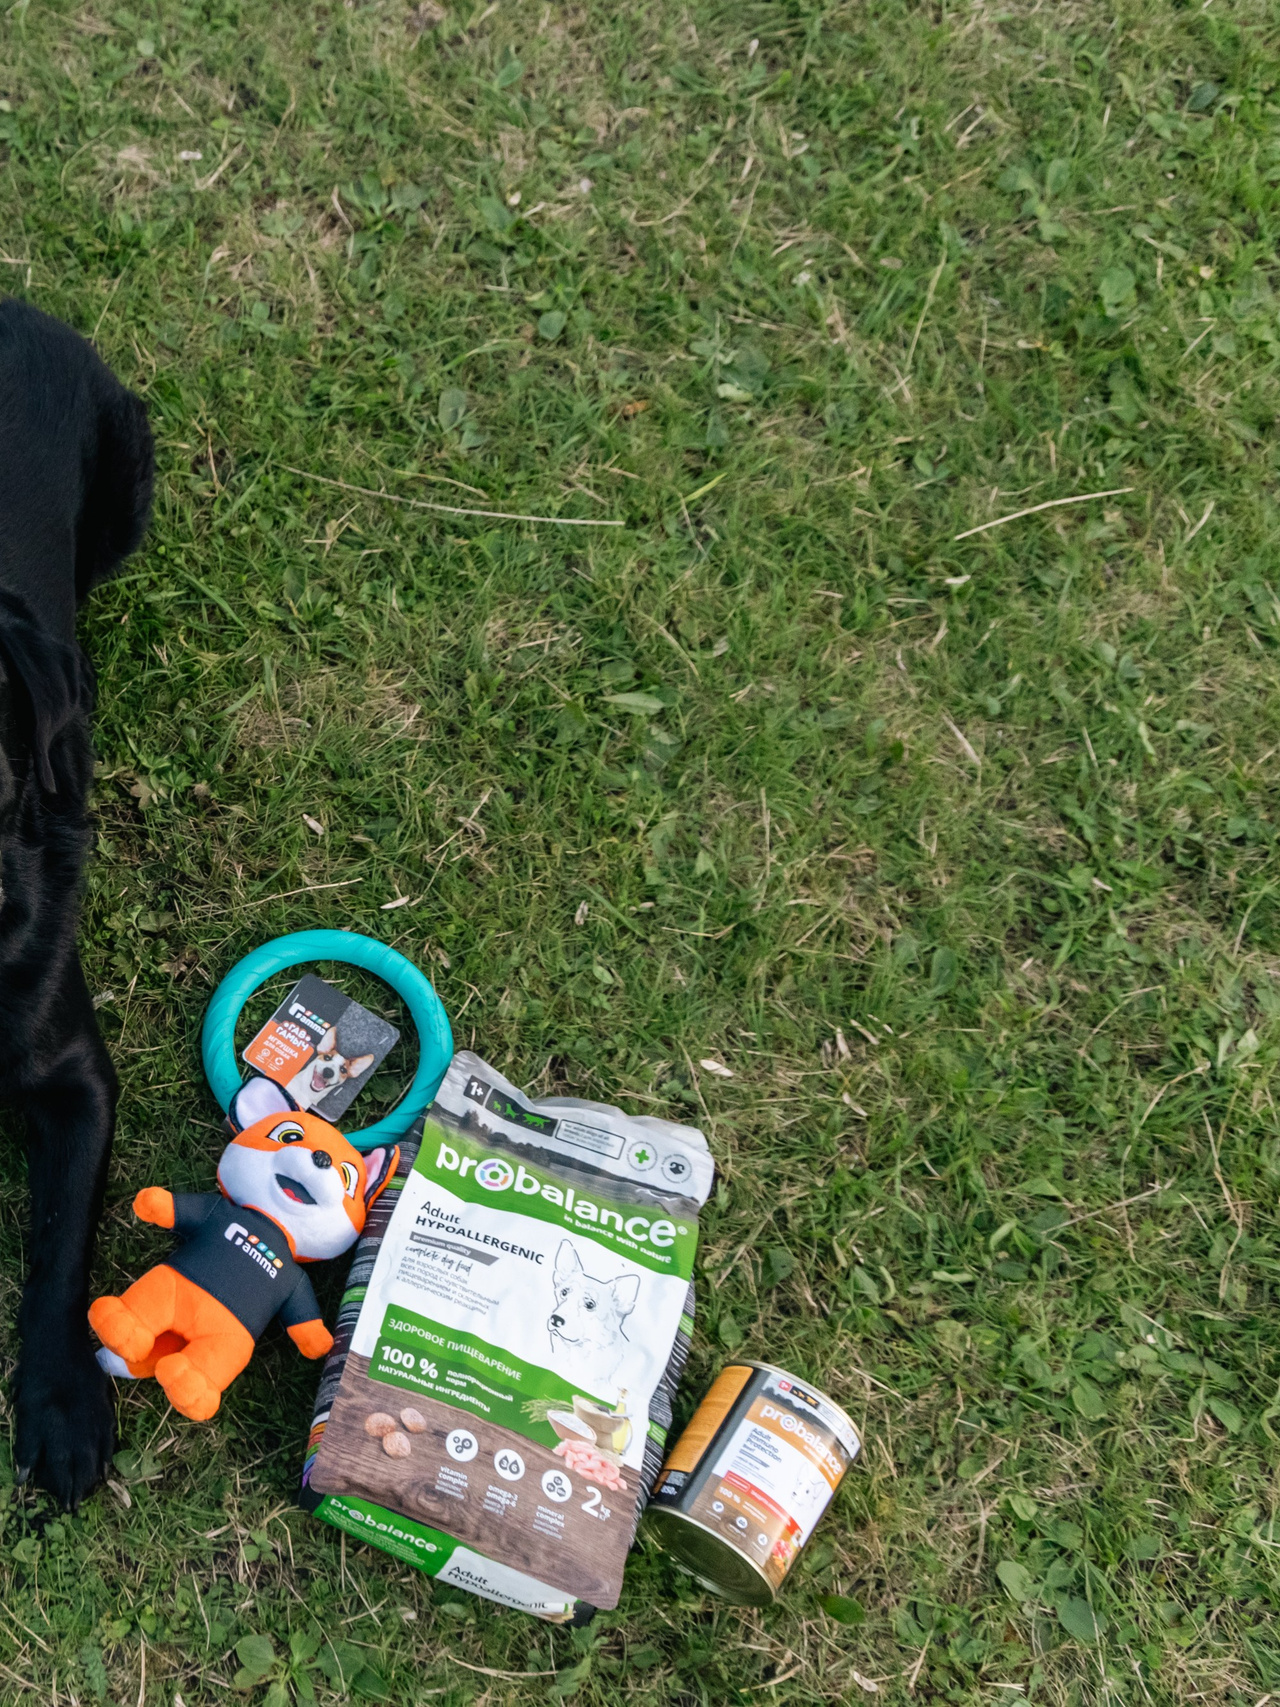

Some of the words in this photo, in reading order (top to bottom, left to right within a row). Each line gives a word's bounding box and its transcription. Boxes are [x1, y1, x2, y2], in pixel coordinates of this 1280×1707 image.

[268, 1035, 298, 1058] ИГРУШКА
[276, 1027, 309, 1051] ГАМЫЧ
[470, 1081, 484, 1097] 1+
[436, 1143, 676, 1247] probalance
[421, 1201, 461, 1225] Adult
[224, 1223, 277, 1279] Gamma
[413, 1234, 446, 1248] premium
[446, 1242, 471, 1256] quality
[415, 1216, 545, 1265] HYPOALLERGENIC
[564, 1214, 572, 1223] in
[574, 1217, 614, 1239] balance
[616, 1233, 638, 1250] with
[640, 1246, 672, 1264] nature
[405, 1245, 439, 1261] complete
[441, 1254, 455, 1269] dog
[455, 1259, 473, 1277] food
[416, 1260, 449, 1276] взрослых
[450, 1273, 468, 1285] собак
[398, 1269, 451, 1293] пищеварением
[400, 1263, 416, 1272] всех
[418, 1267, 438, 1281] пород
[443, 1277, 500, 1306] чувствительным
[401, 1278, 453, 1302] аллергическим
[388, 1318, 445, 1347] ЗДОРОВОЕ
[446, 1340, 522, 1381] ПИЩЕВАРЕНИЕ
[381, 1345, 415, 1369] 100
[419, 1357, 438, 1379] %
[378, 1364, 434, 1390] НАТУРАЛЬНЫЕ
[435, 1385, 491, 1413] ИНГРЕДИЕНТЫ
[445, 1376, 466, 1387] корм
[447, 1370, 513, 1402] полнорационный
[750, 1433, 779, 1454] Immuno
[753, 1428, 771, 1441] Adult
[746, 1438, 782, 1463] Protection
[438, 1472, 469, 1488] complex
[440, 1466, 468, 1480] vitamin
[486, 1490, 516, 1507] omega-6
[487, 1484, 518, 1501] omega-3
[581, 1485, 602, 1517] 2
[536, 1511, 565, 1528] complex
[537, 1505, 565, 1521] mineral
[329, 1498, 438, 1553] probalance
[450, 1566, 489, 1585] Adult
